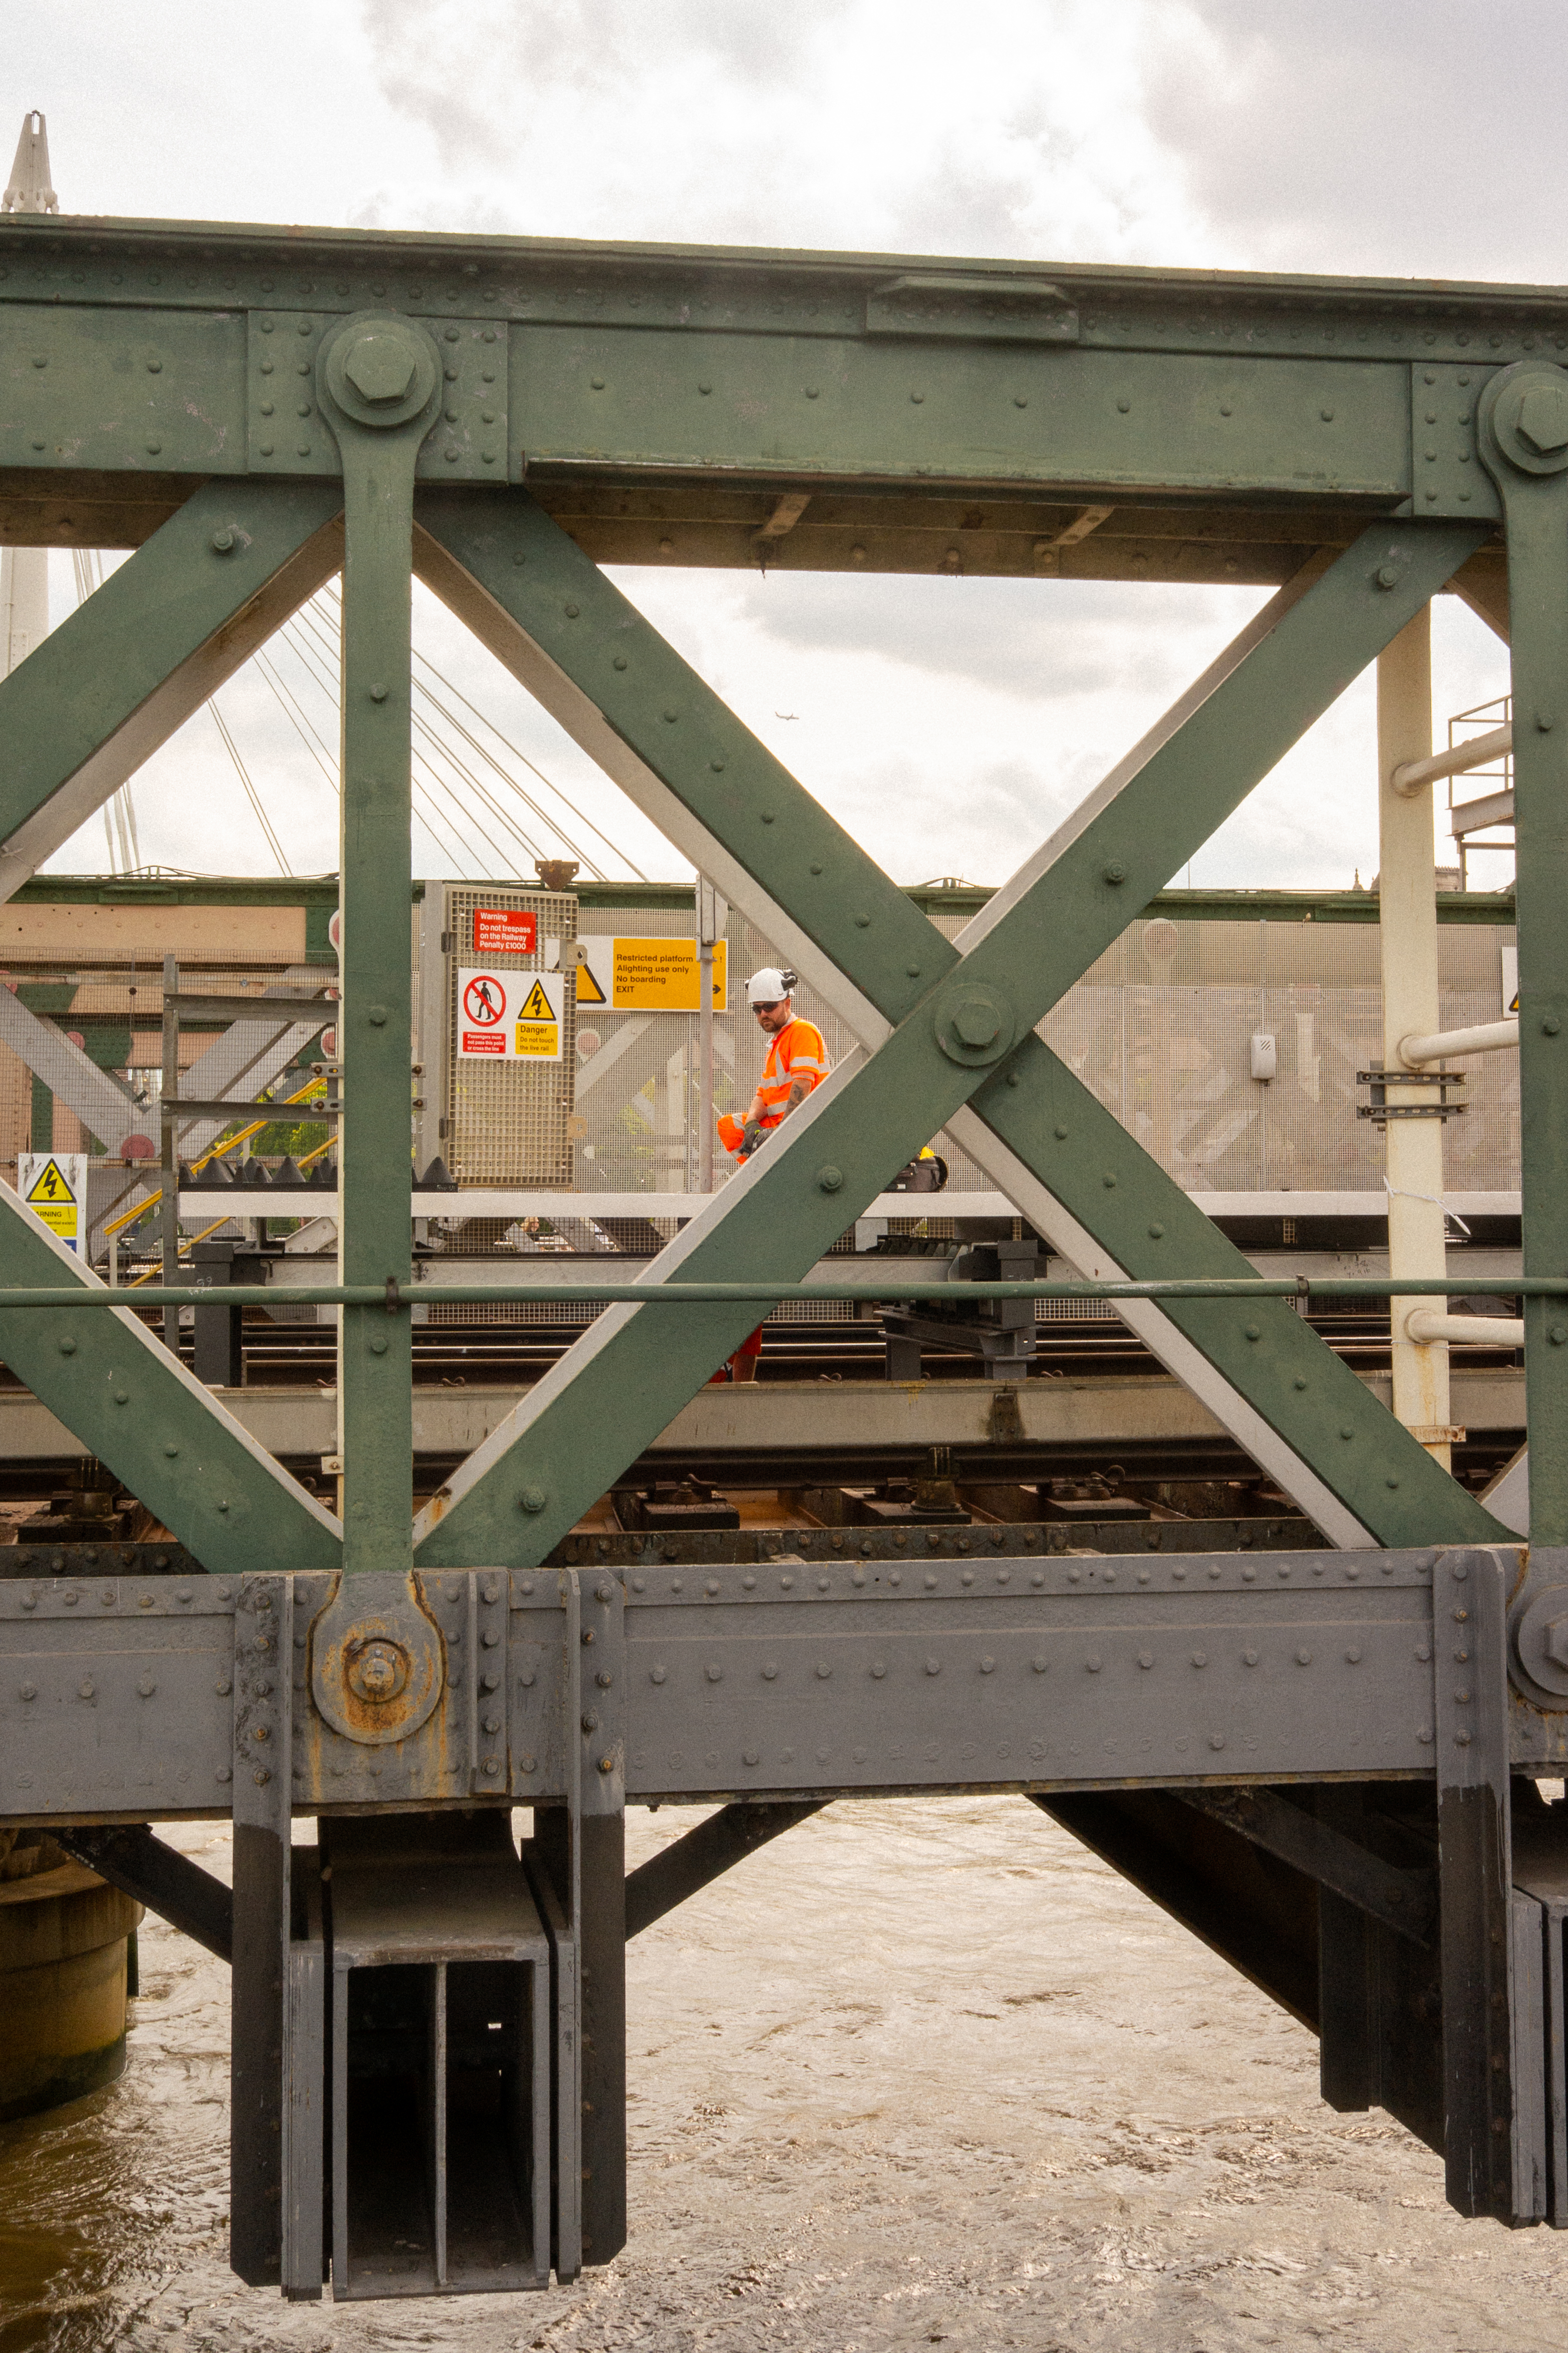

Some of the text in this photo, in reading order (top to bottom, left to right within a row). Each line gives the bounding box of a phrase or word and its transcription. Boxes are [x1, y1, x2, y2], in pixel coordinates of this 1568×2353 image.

[480, 912, 507, 922] Warning
[502, 925, 531, 933] trespass
[501, 933, 526, 942] Railway
[480, 940, 526, 950] Penalty £1000
[660, 955, 693, 963] platform
[617, 965, 653, 973] Alighting
[672, 966, 689, 974] only
[630, 976, 666, 984] boarding
[520, 1025, 547, 1035] Danger
